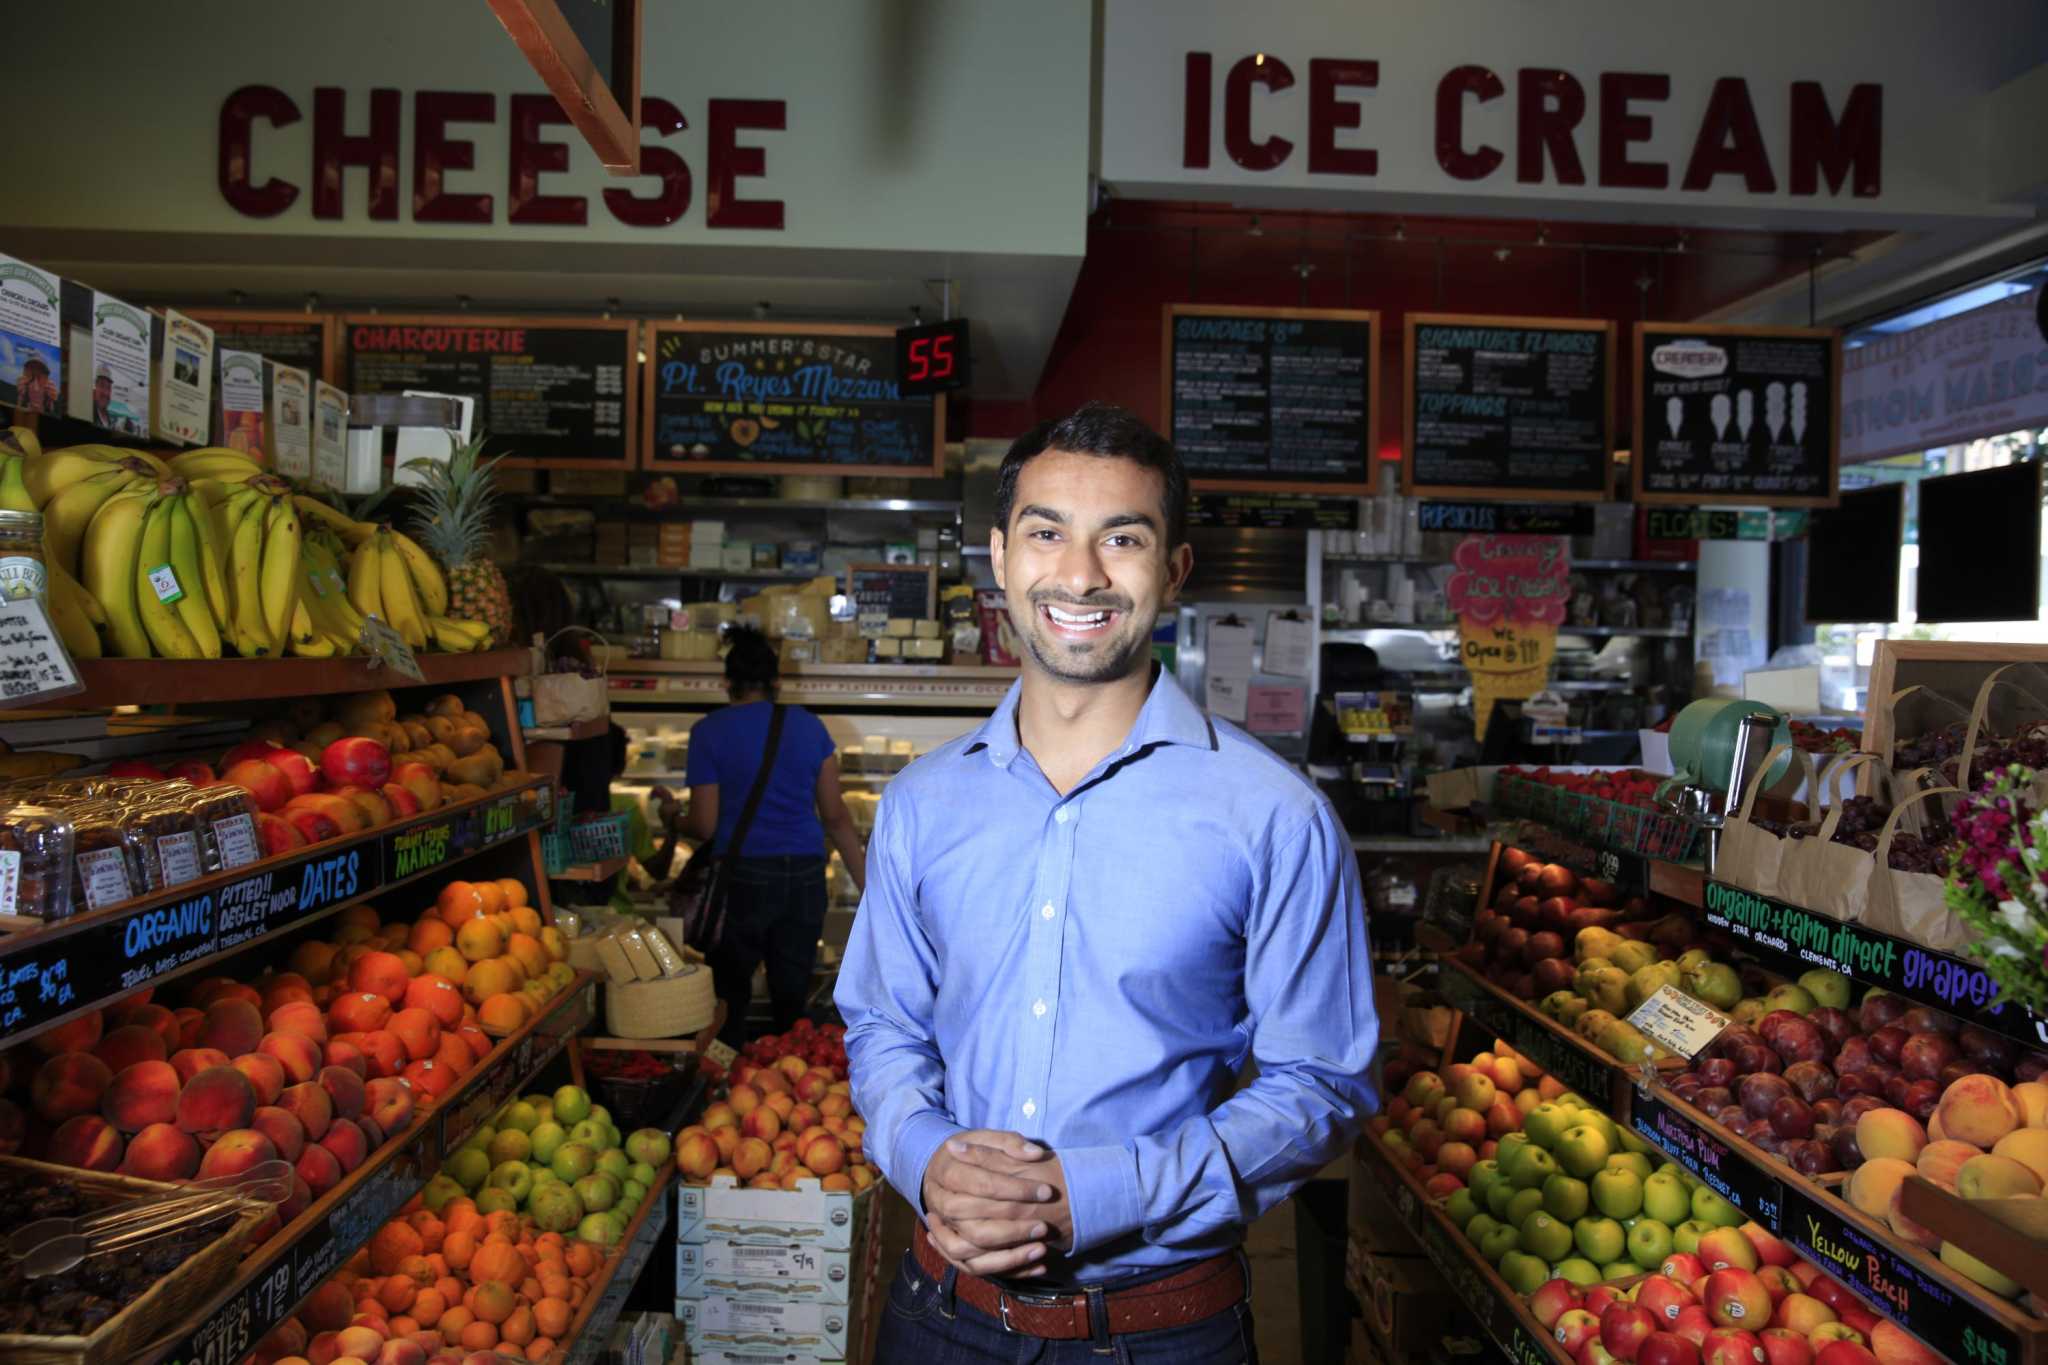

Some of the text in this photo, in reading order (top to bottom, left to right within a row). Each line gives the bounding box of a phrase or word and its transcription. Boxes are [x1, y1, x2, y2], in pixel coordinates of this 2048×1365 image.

[1183, 51, 1884, 199] ICE CREAM
[218, 84, 787, 231] CHEESE
[353, 326, 527, 353] CHARCUTERIE
[1176, 318, 1266, 343] SUNDAES
[1418, 327, 1597, 354] SIGNATURE FLAVORS
[700, 338, 872, 375] SUMMER'S STAR
[907, 335, 954, 382] 55
[660, 360, 706, 394] Pt.
[714, 360, 793, 402] Reyes
[1418, 393, 1507, 417] TOPPINGS
[1420, 504, 1496, 529] POPSICLES
[395, 839, 446, 880] MANGO
[124, 850, 361, 959] ORGANIC DEGLET NOOR DATES
[219, 872, 273, 908] PITTED!!
[1707, 913, 1730, 928] HIDDEN
[1732, 923, 1750, 938] STAR
[1754, 930, 1789, 953] ORCHARDS
[1831, 925, 1897, 978] direct
[8, 962, 39, 988] DATES
[1698, 1138, 1720, 1171] PLUM
[1806, 1213, 1861, 1272] YELLOW
[1865, 1254, 1910, 1313] PEACH
[192, 1288, 250, 1355] medjool
